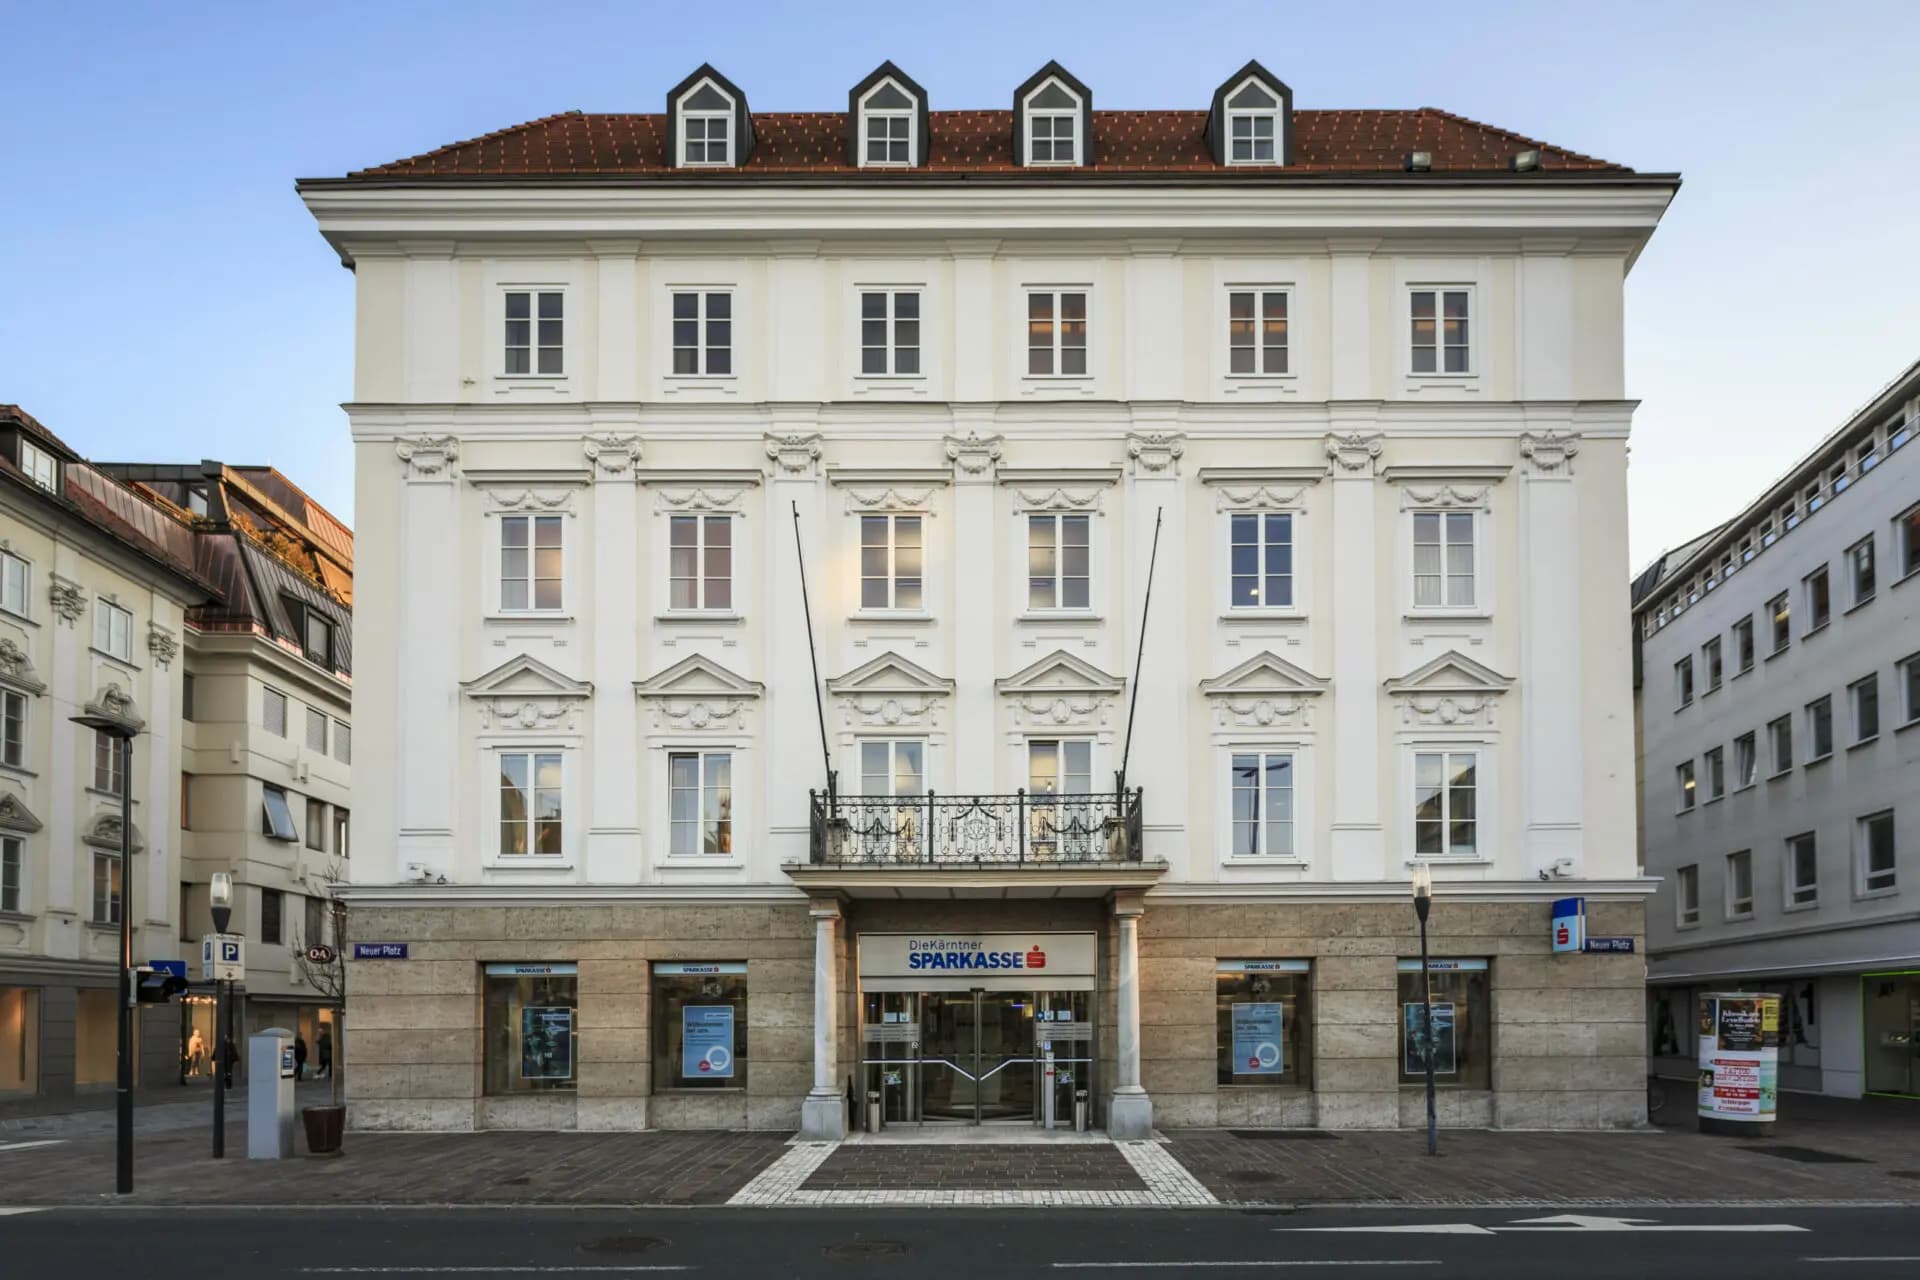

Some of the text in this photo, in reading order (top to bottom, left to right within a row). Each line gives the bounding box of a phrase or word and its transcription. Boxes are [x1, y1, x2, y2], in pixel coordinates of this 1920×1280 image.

[360, 945, 401, 956] Neuer Platz
[909, 940, 983, 950] DieKärntner
[1590, 940, 1631, 950] Neuer Platz
[225, 944, 236, 960] P
[909, 952, 1024, 969] SPARKASSE
